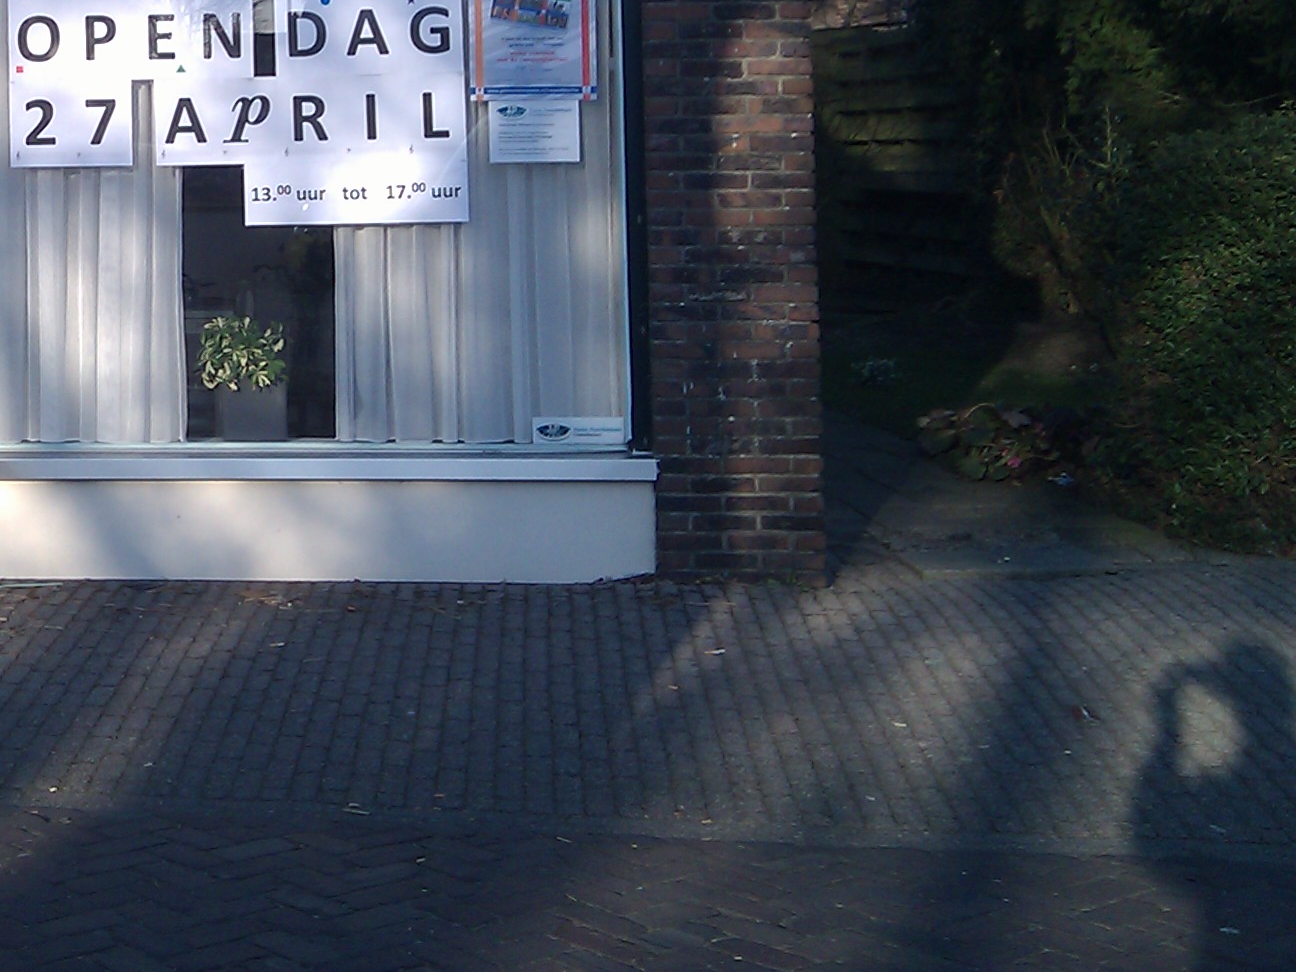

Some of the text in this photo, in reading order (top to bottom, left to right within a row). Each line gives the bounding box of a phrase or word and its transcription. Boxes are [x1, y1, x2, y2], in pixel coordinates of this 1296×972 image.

[17, 7, 451, 62] OPEN DAG
[25, 98, 116, 146] 27
[296, 188, 326, 201] uur
[342, 187, 368, 200] tot
[431, 186, 462, 198] uur
